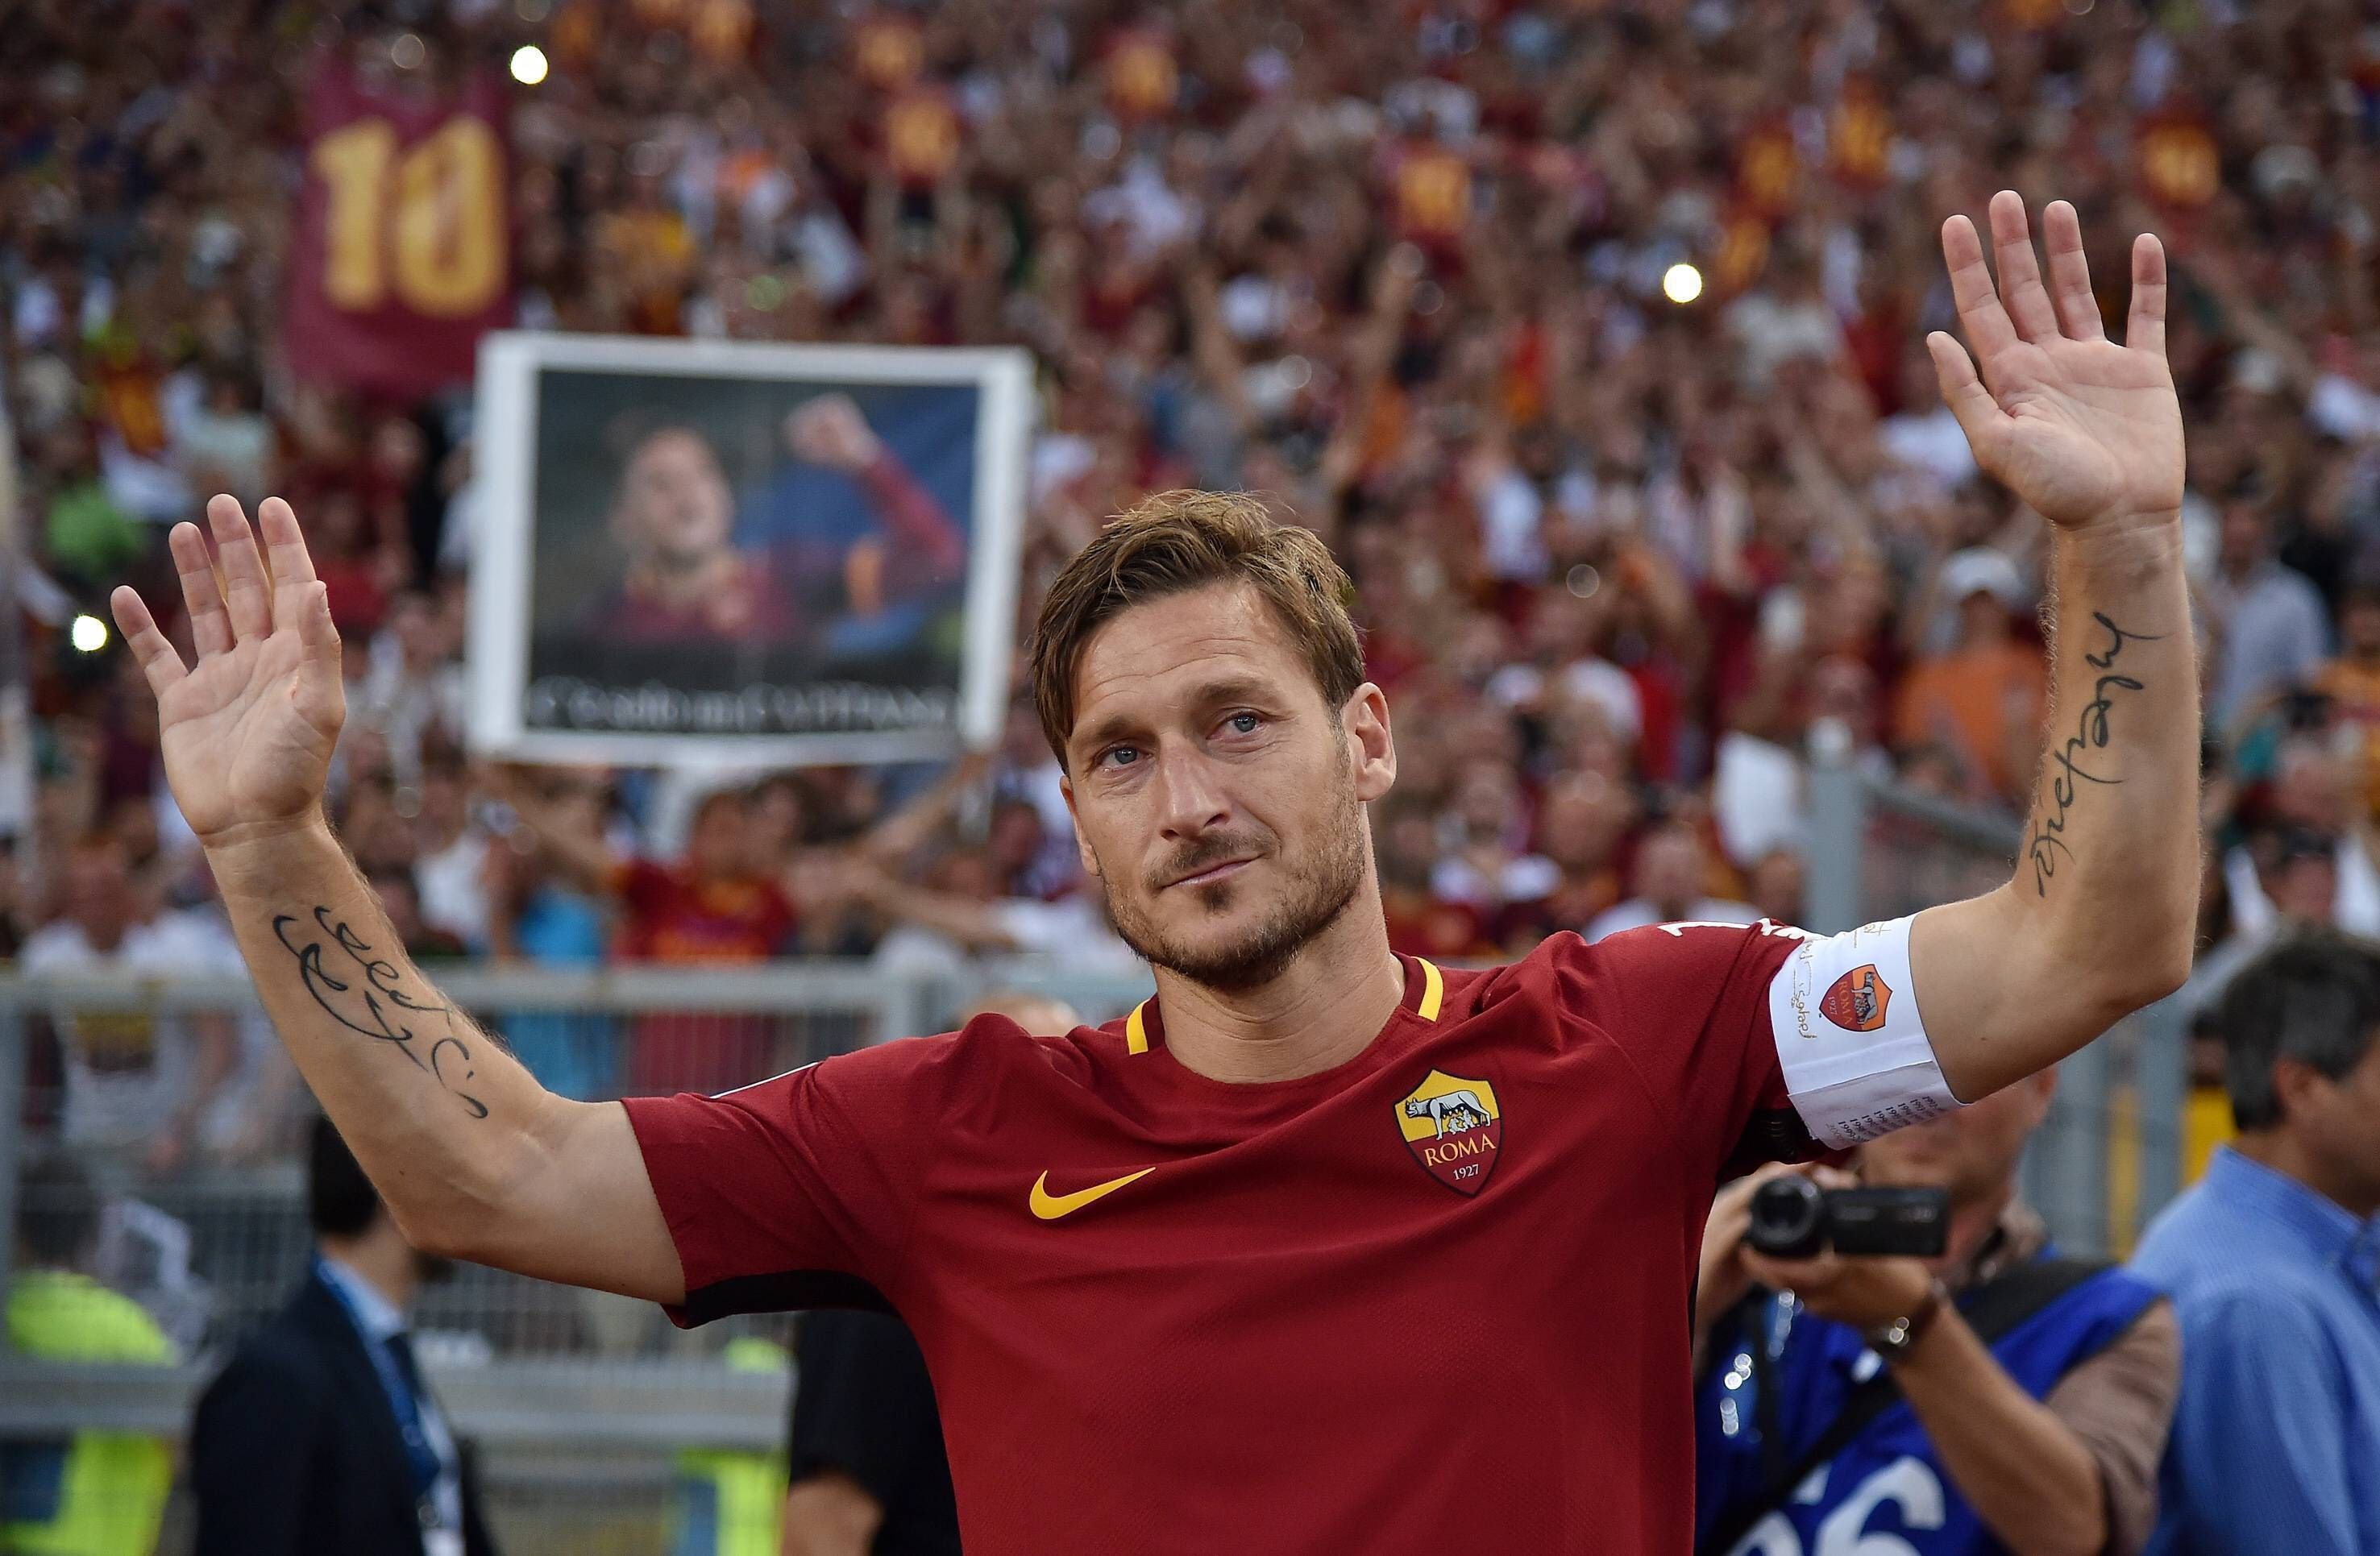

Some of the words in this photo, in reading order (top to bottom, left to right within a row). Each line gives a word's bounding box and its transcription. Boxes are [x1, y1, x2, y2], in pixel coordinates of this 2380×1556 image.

[313, 117, 508, 313] 10
[1828, 996, 1838, 1015] 1927
[1838, 980, 1853, 1025] ROMA
[1424, 1133, 1496, 1167] ROMA
[1453, 1164, 1480, 1180] 1927
